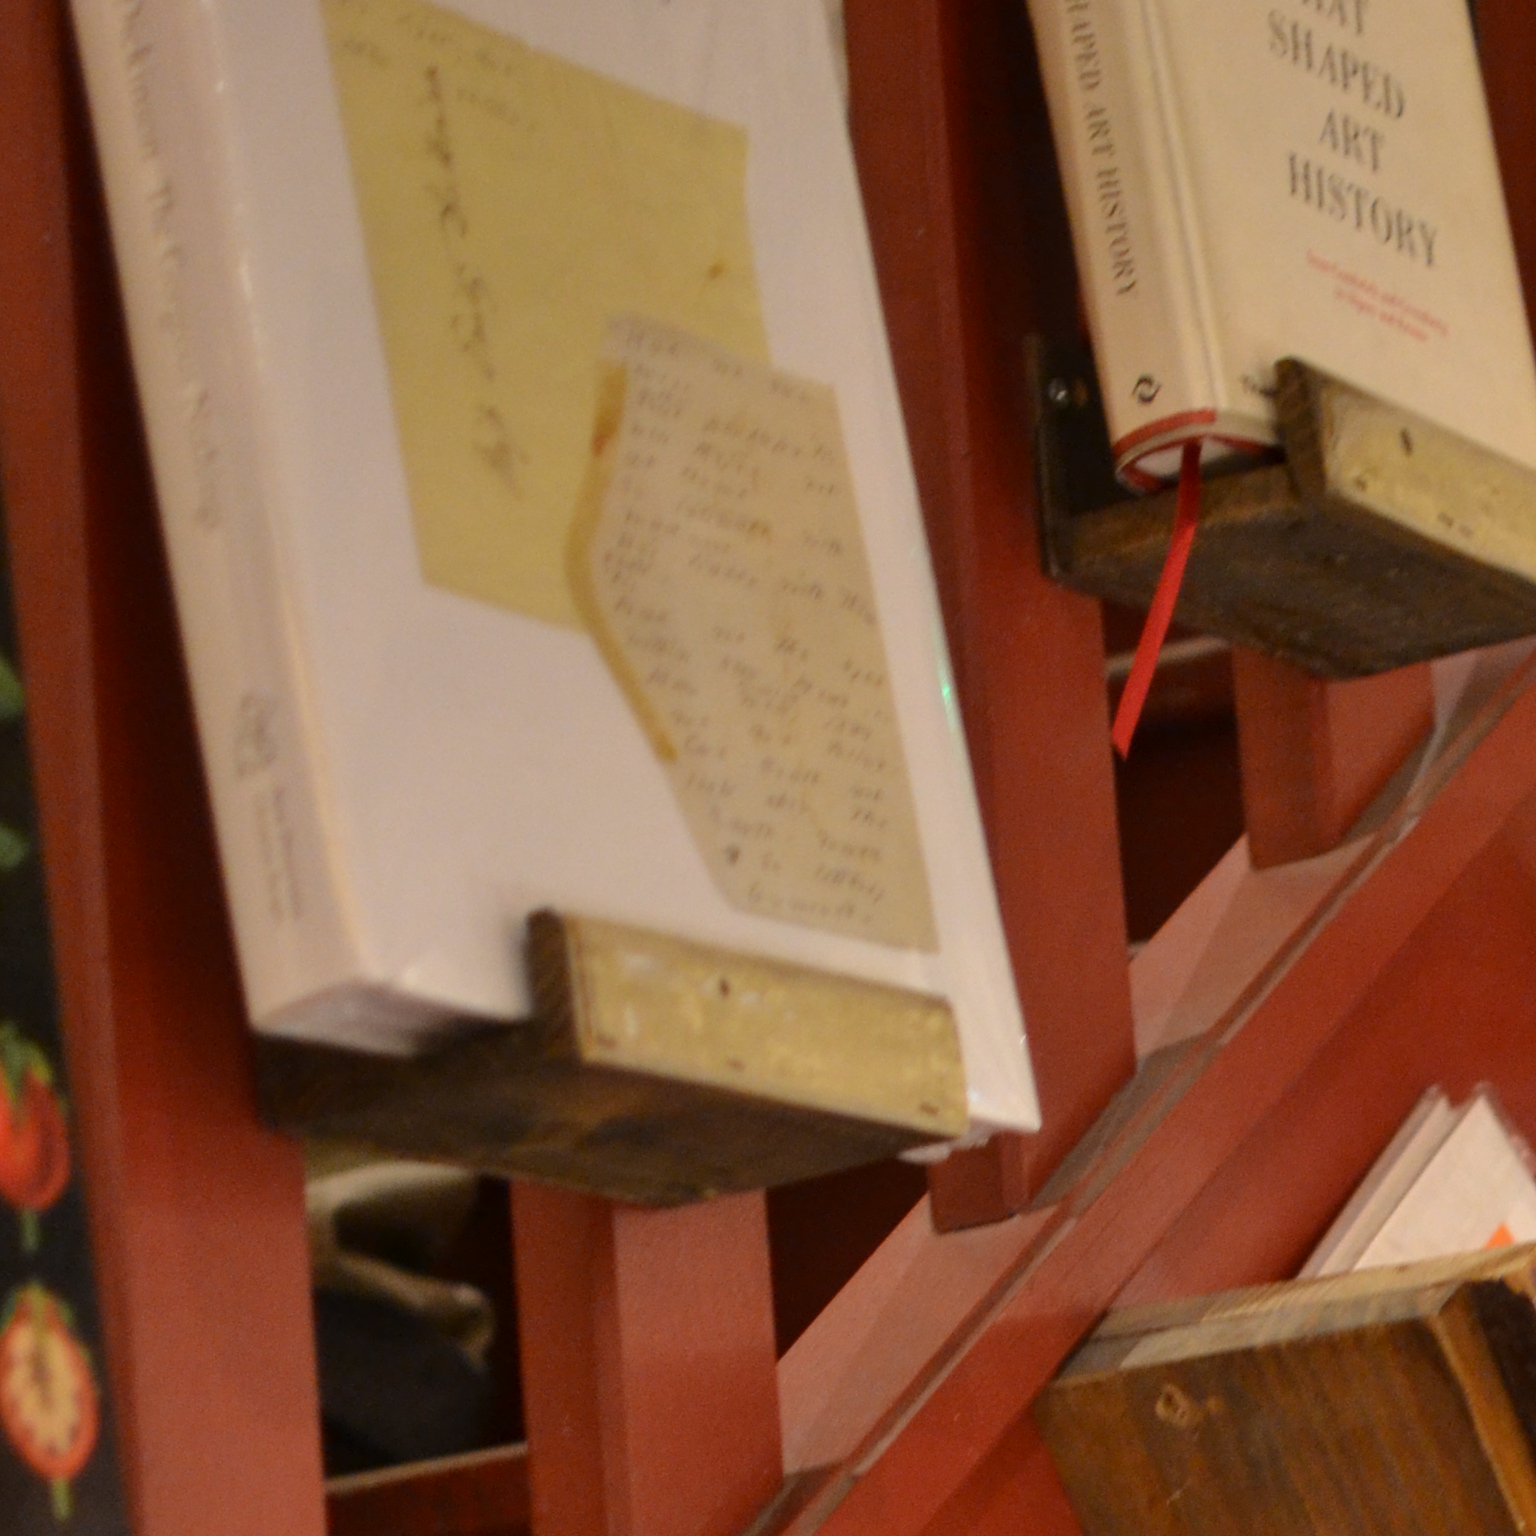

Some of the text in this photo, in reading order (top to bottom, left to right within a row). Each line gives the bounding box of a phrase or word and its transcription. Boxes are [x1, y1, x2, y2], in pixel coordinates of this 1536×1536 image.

[1267, 9, 1406, 120] SHAPED
[1065, 0, 1138, 297] HAPED ART HISTORY
[1319, 110, 1386, 172] ART
[1287, 153, 1438, 268] HISTORY
